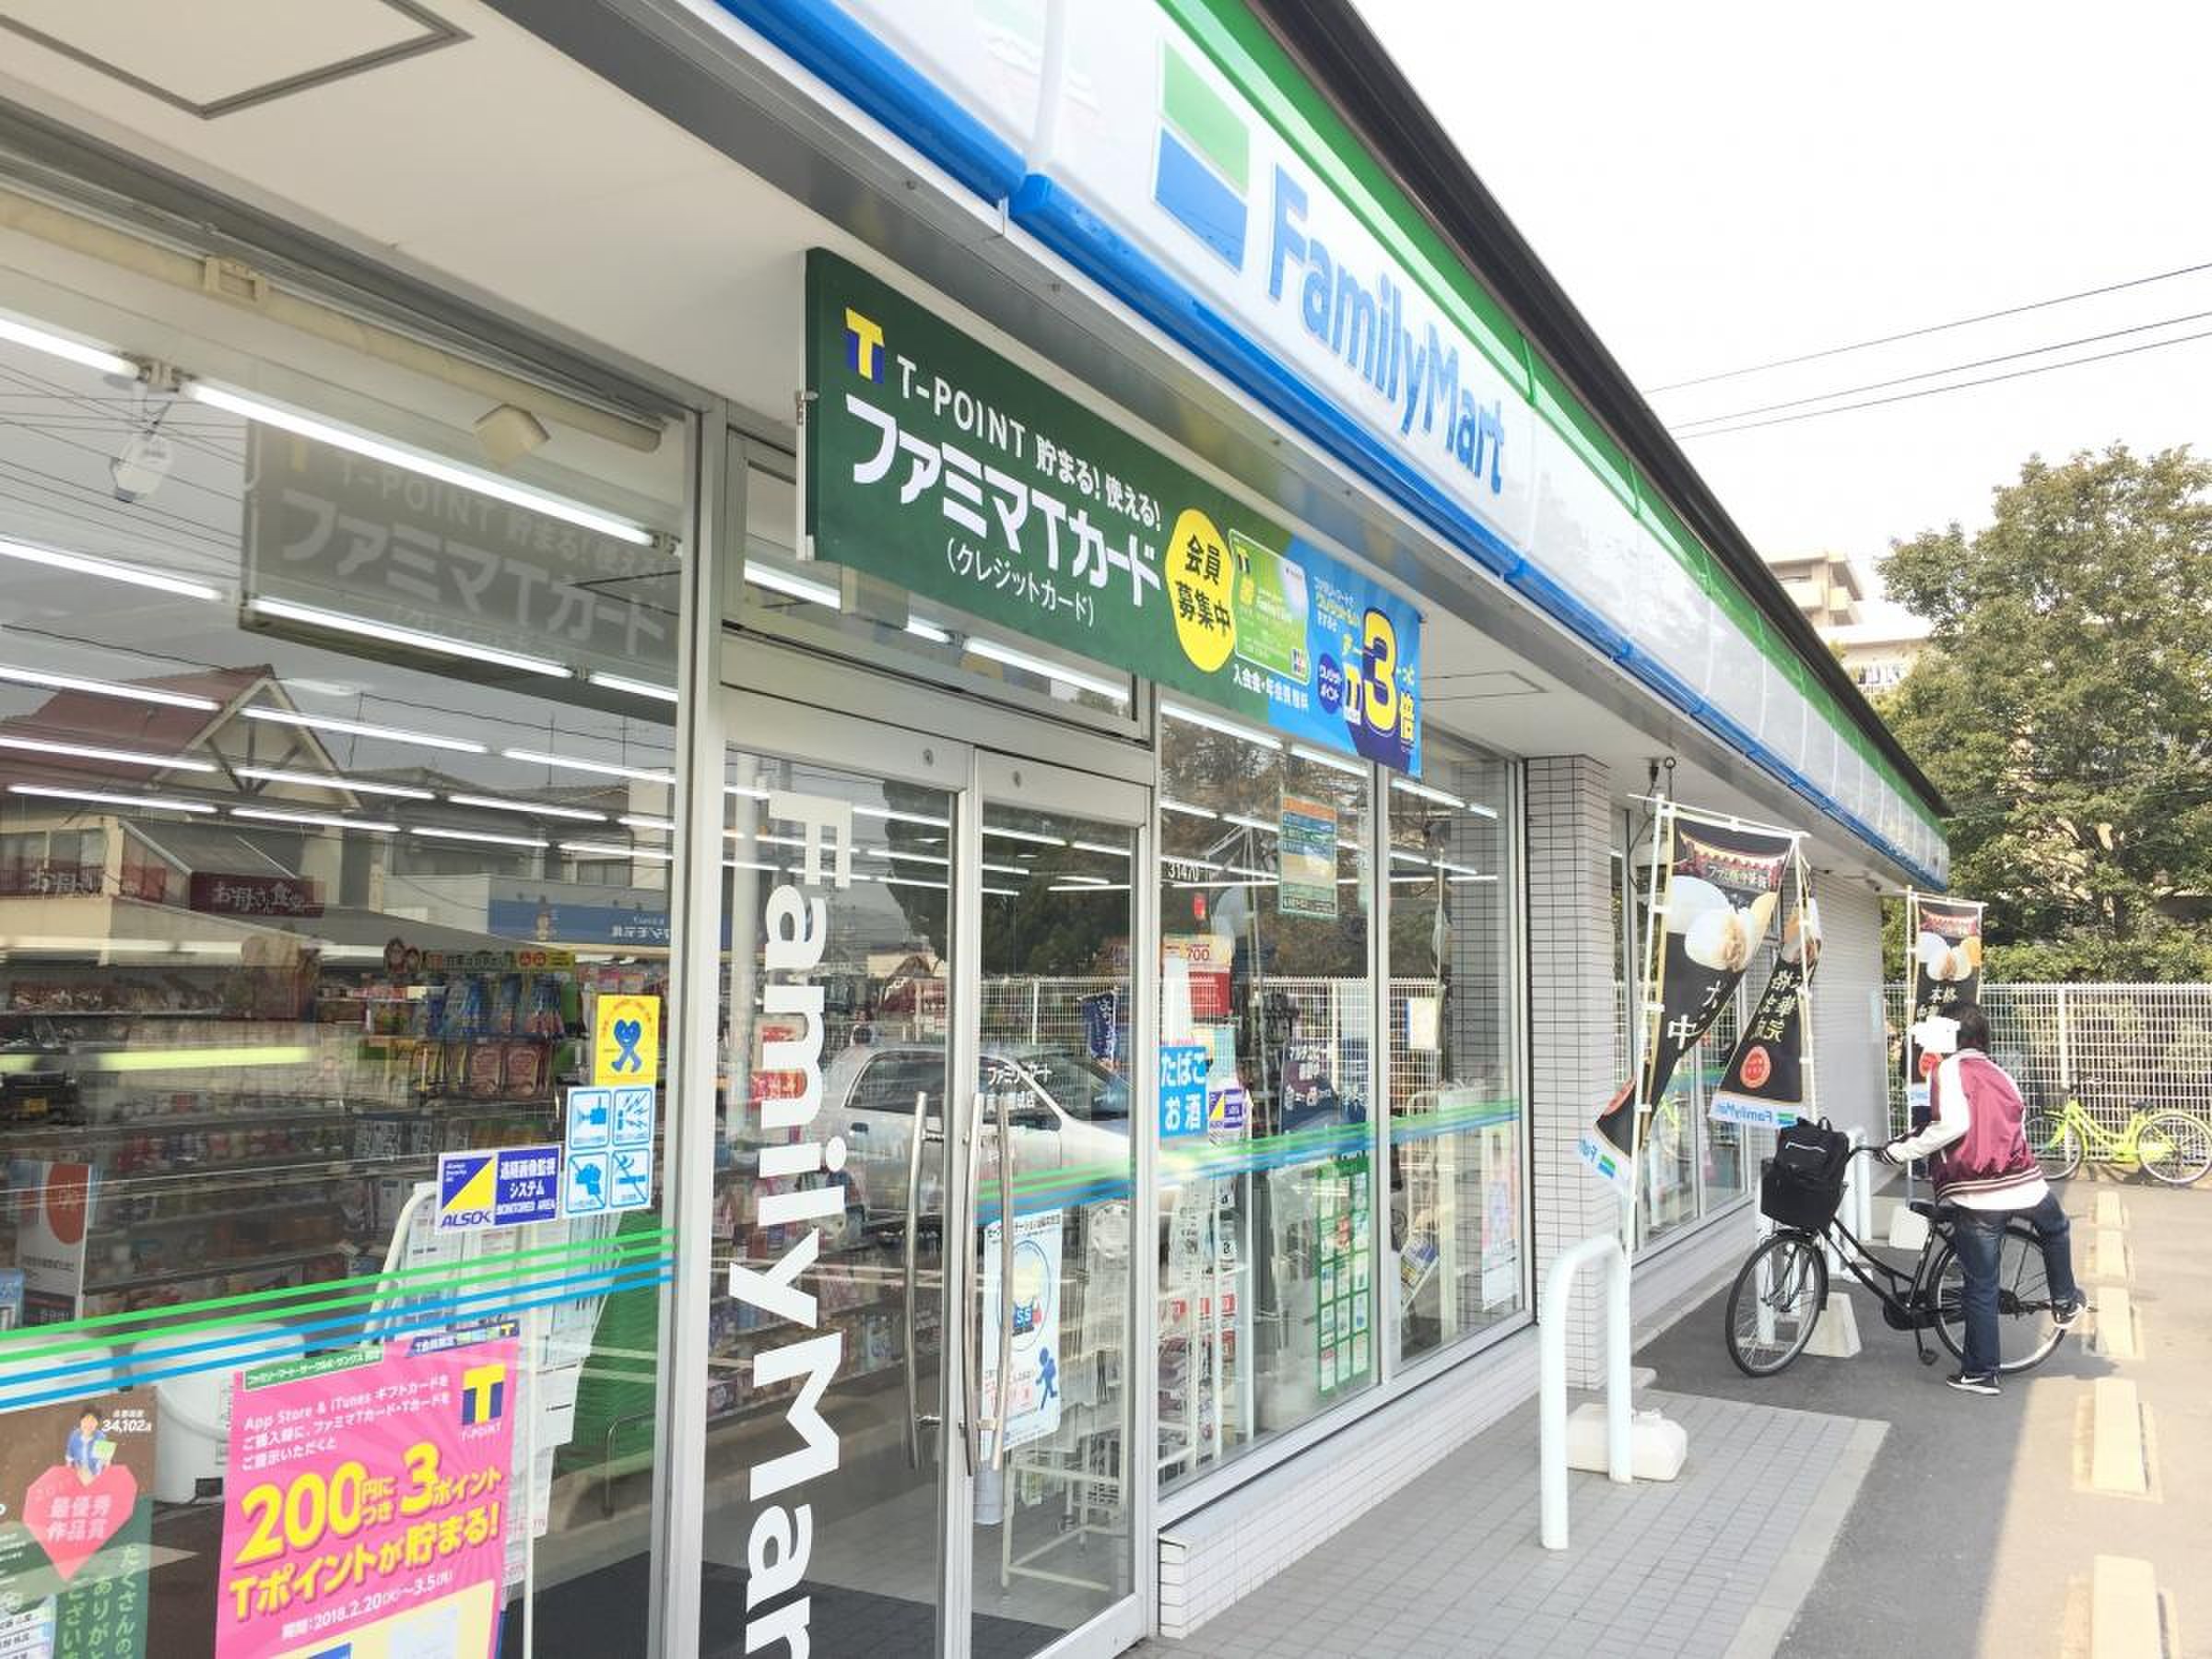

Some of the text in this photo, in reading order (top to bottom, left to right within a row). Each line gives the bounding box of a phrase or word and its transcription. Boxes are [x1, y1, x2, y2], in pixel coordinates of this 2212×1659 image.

[1268, 162, 1506, 495] FamilyMart
[897, 354, 1025, 458] T-POINT
[845, 393, 1161, 607] ファミマTカード
[947, 537, 1094, 627] (クレジットカード)
[1185, 534, 1220, 585] 会員
[1175, 580, 1231, 637] 募集中
[1363, 608, 1397, 731] 3
[1161, 1051, 1206, 1087] たばこ
[1164, 1094, 1202, 1131] お酒
[510, 1179, 546, 1199] システム
[441, 1211, 492, 1228] ALSOK
[244, 1414, 274, 1432] App
[277, 1406, 312, 1425] Store
[113, 1544, 138, 1659] たくさんの
